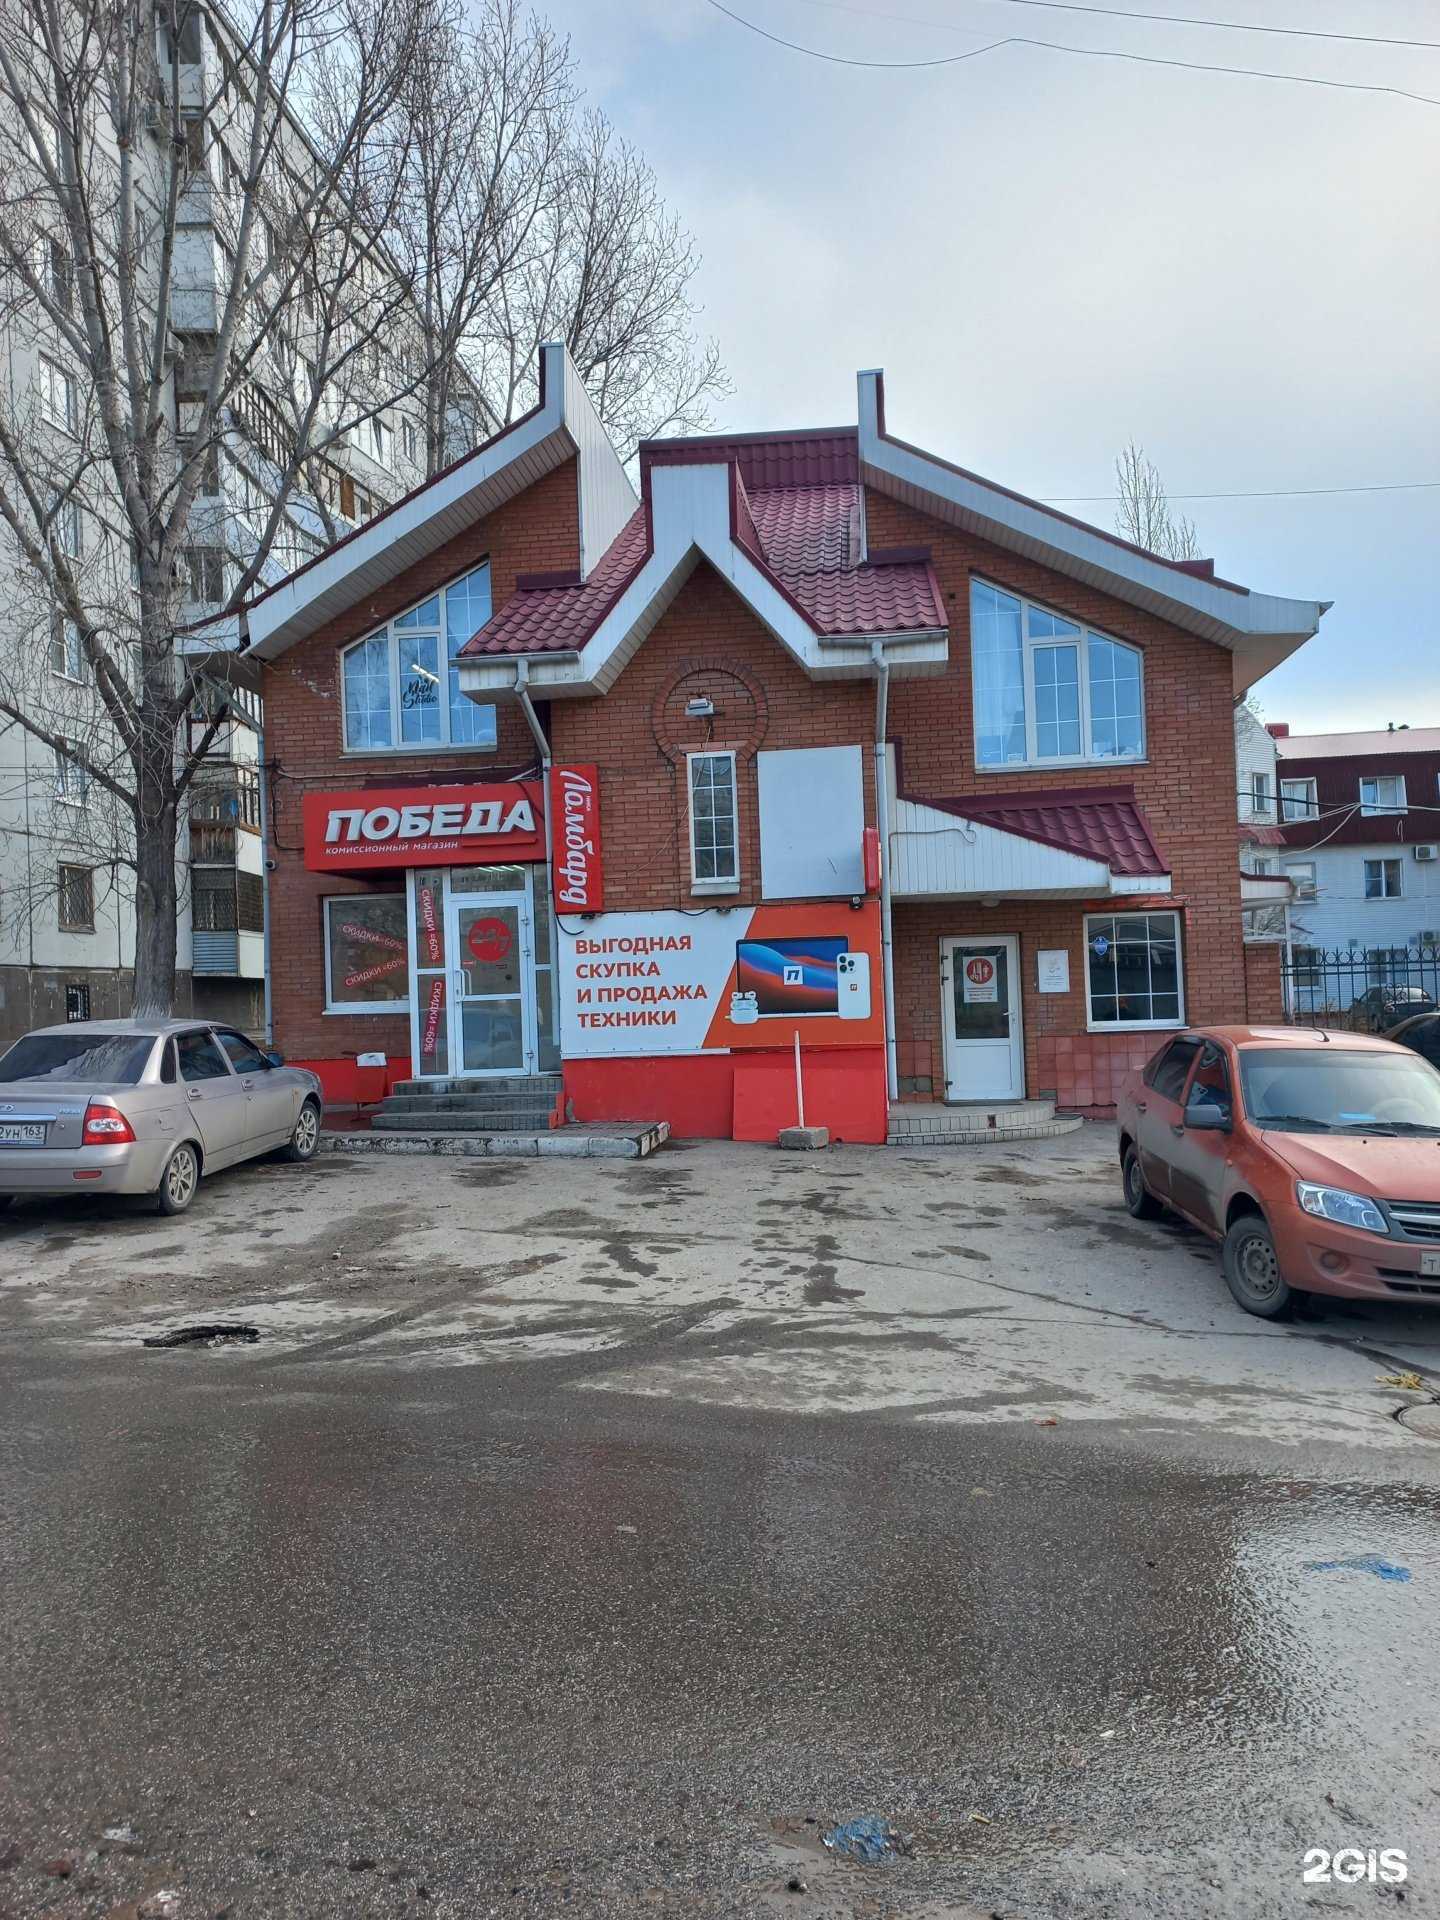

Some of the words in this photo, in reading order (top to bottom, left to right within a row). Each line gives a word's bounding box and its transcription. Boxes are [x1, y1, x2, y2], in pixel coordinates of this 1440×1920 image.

[324, 800, 536, 842] ПОБЕДА
[325, 842, 409, 855] комиссионный
[413, 840, 458, 851] магазин
[559, 770, 594, 905] Ломбард
[422, 889, 436, 931] СКИДКИ
[575, 935, 692, 956] ВЫГОДНАЯ
[575, 961, 661, 979] СКУПКА
[428, 982, 442, 1024] СКИДКИ
[577, 988, 592, 1004] И
[597, 983, 708, 1004] ПРОДАЖА
[577, 1010, 677, 1028] ТЕХНИКИ
[23, 1126, 41, 1136] 163
